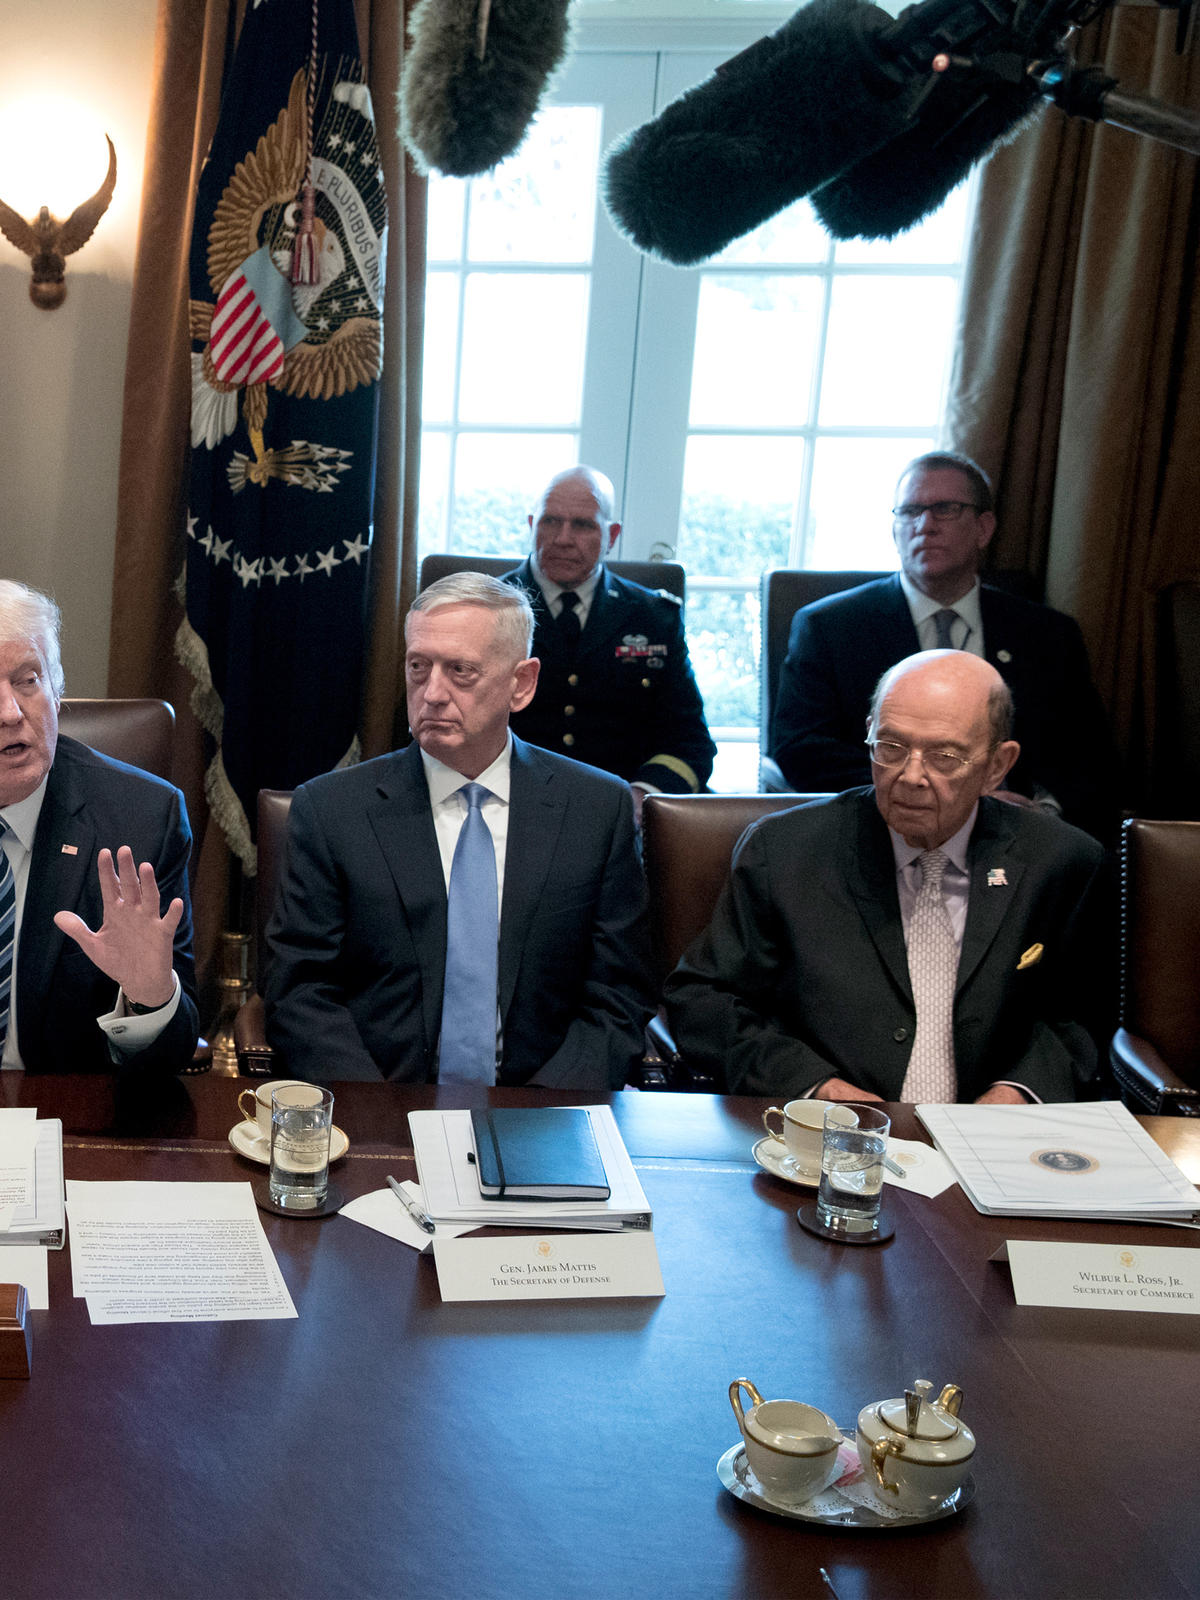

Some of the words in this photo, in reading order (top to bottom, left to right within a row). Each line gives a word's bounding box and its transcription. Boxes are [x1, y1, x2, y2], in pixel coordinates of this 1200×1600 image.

[316, 168, 326, 185] E
[327, 175, 375, 255] PLURIBUS
[499, 1264, 526, 1274] GEN.
[527, 1264, 557, 1274] JAMES
[559, 1263, 597, 1273] MATTIS
[491, 1277, 509, 1286] THE
[510, 1277, 558, 1286] SECRETARY
[560, 1276, 571, 1285] OF
[572, 1275, 612, 1285] DEFENSE
[1079, 1271, 1121, 1284] WILBUR
[1136, 1274, 1167, 1287] ROSS,
[1169, 1275, 1184, 1287] JR.
[1072, 1285, 1124, 1296] SECRETARY
[1126, 1288, 1138, 1297] OF
[1140, 1287, 1195, 1300] COMMERCE
